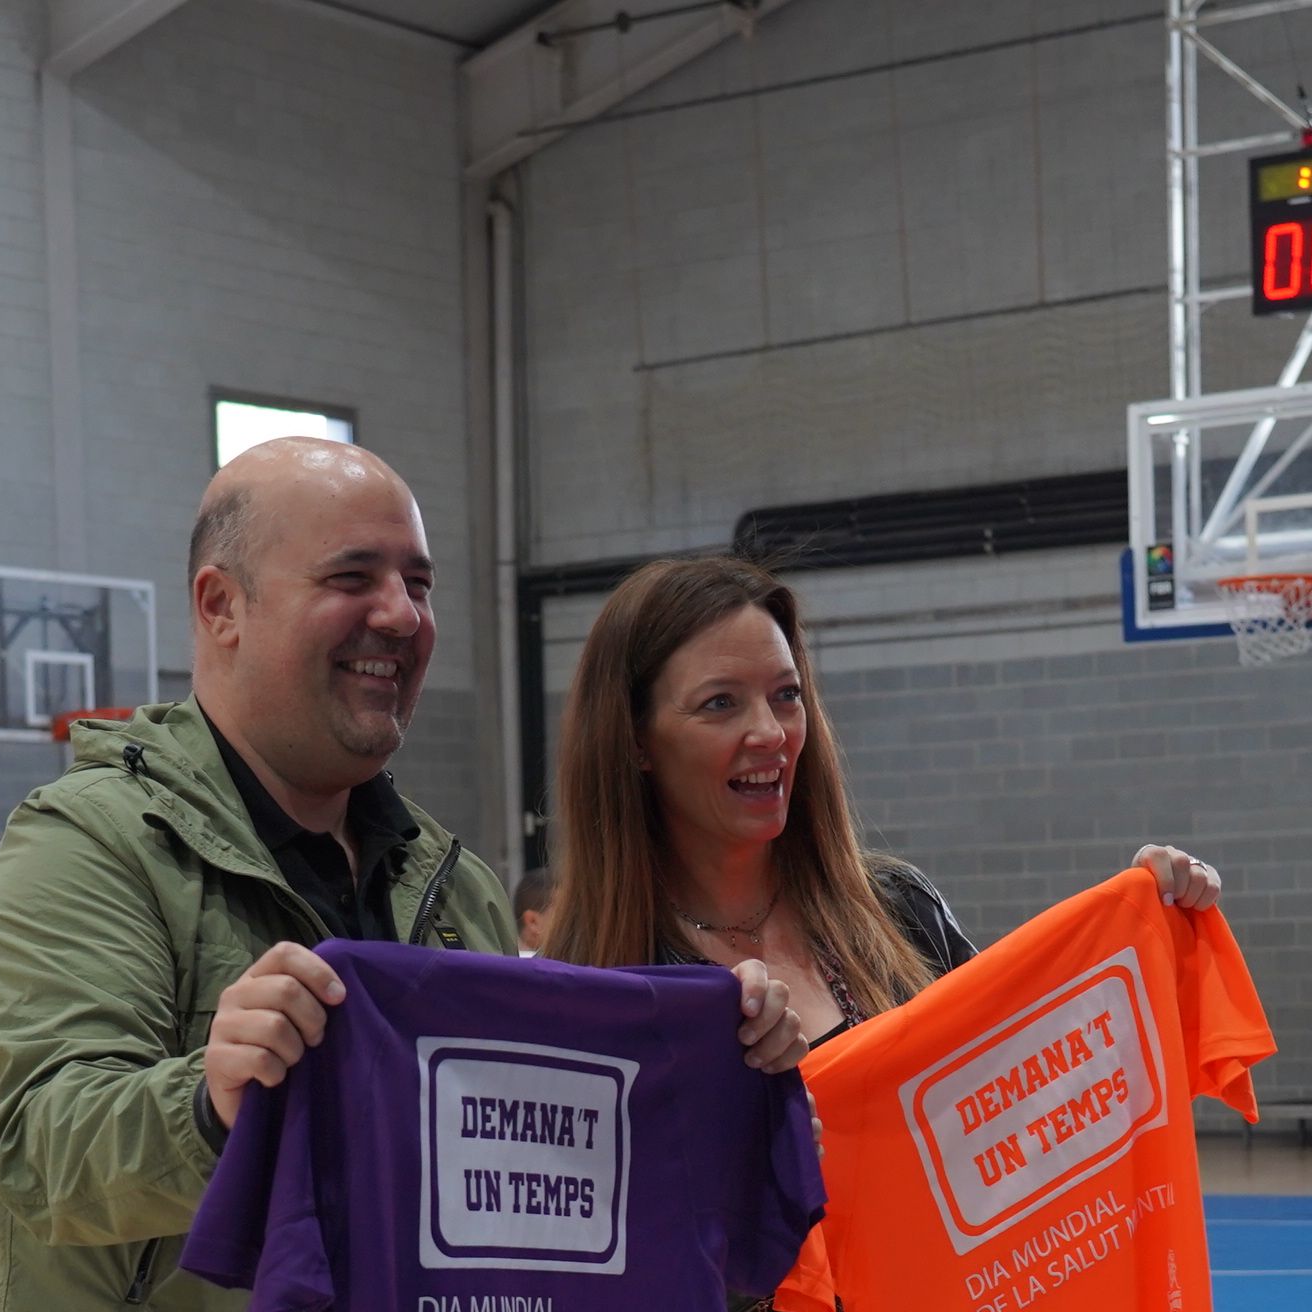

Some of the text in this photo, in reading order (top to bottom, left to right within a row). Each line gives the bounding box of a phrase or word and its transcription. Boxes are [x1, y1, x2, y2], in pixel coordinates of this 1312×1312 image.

[955, 1009, 1117, 1137] DEMANA'T
[460, 1096, 598, 1151] DEMANA'T
[972, 1067, 1129, 1188] UN TEMPS
[463, 1169, 595, 1219] UN TEMPS
[964, 1190, 1126, 1301] DIA MUNDIAL
[1011, 1275, 1047, 1310] LA
[1047, 1223, 1120, 1288] SALUT
